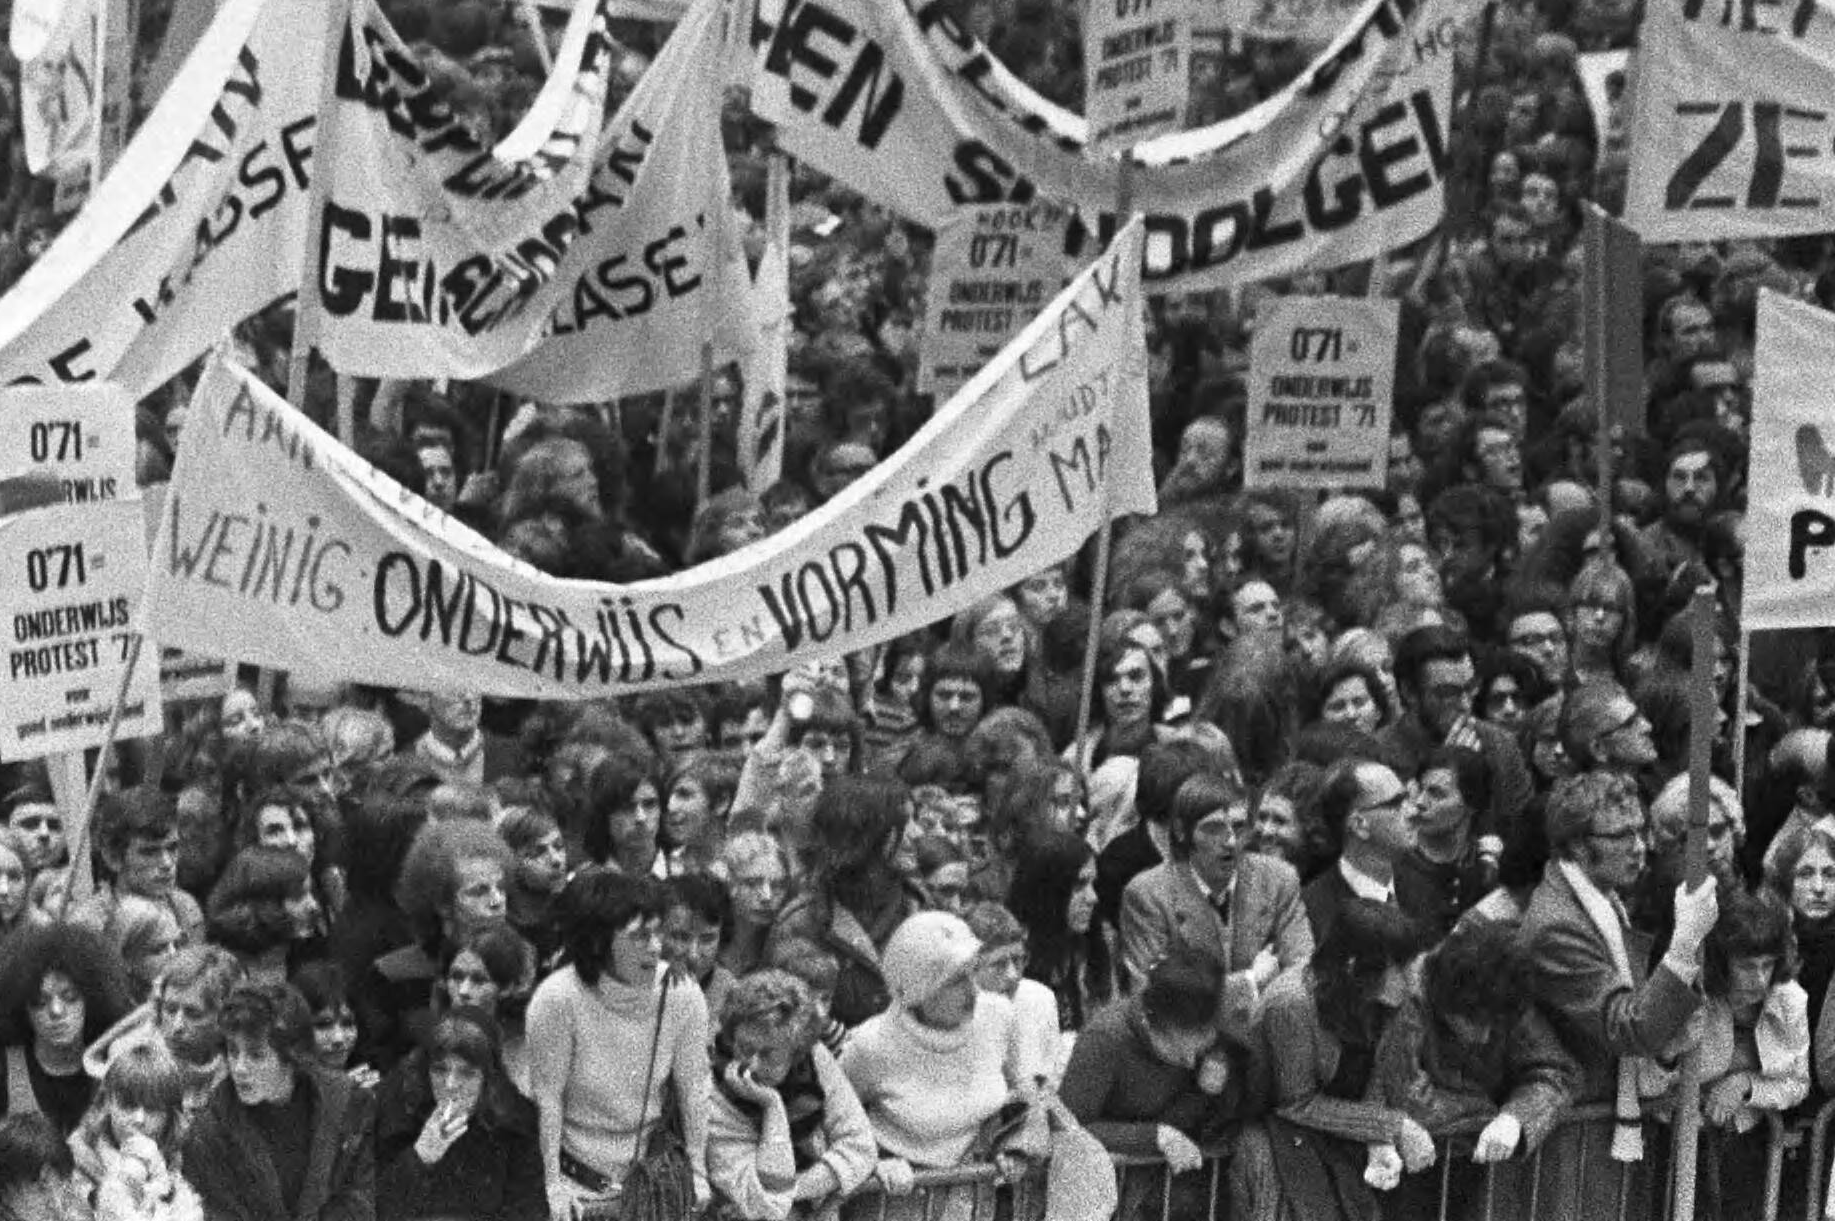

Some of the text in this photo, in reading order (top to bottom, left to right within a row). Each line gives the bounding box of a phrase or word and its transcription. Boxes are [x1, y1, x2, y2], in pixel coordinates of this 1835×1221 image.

[168, 496, 352, 613] WEINIG
[757, 449, 1036, 652] VORMING
[13, 597, 130, 645] ONDERWIJS
[9, 637, 100, 683] PROTEST
